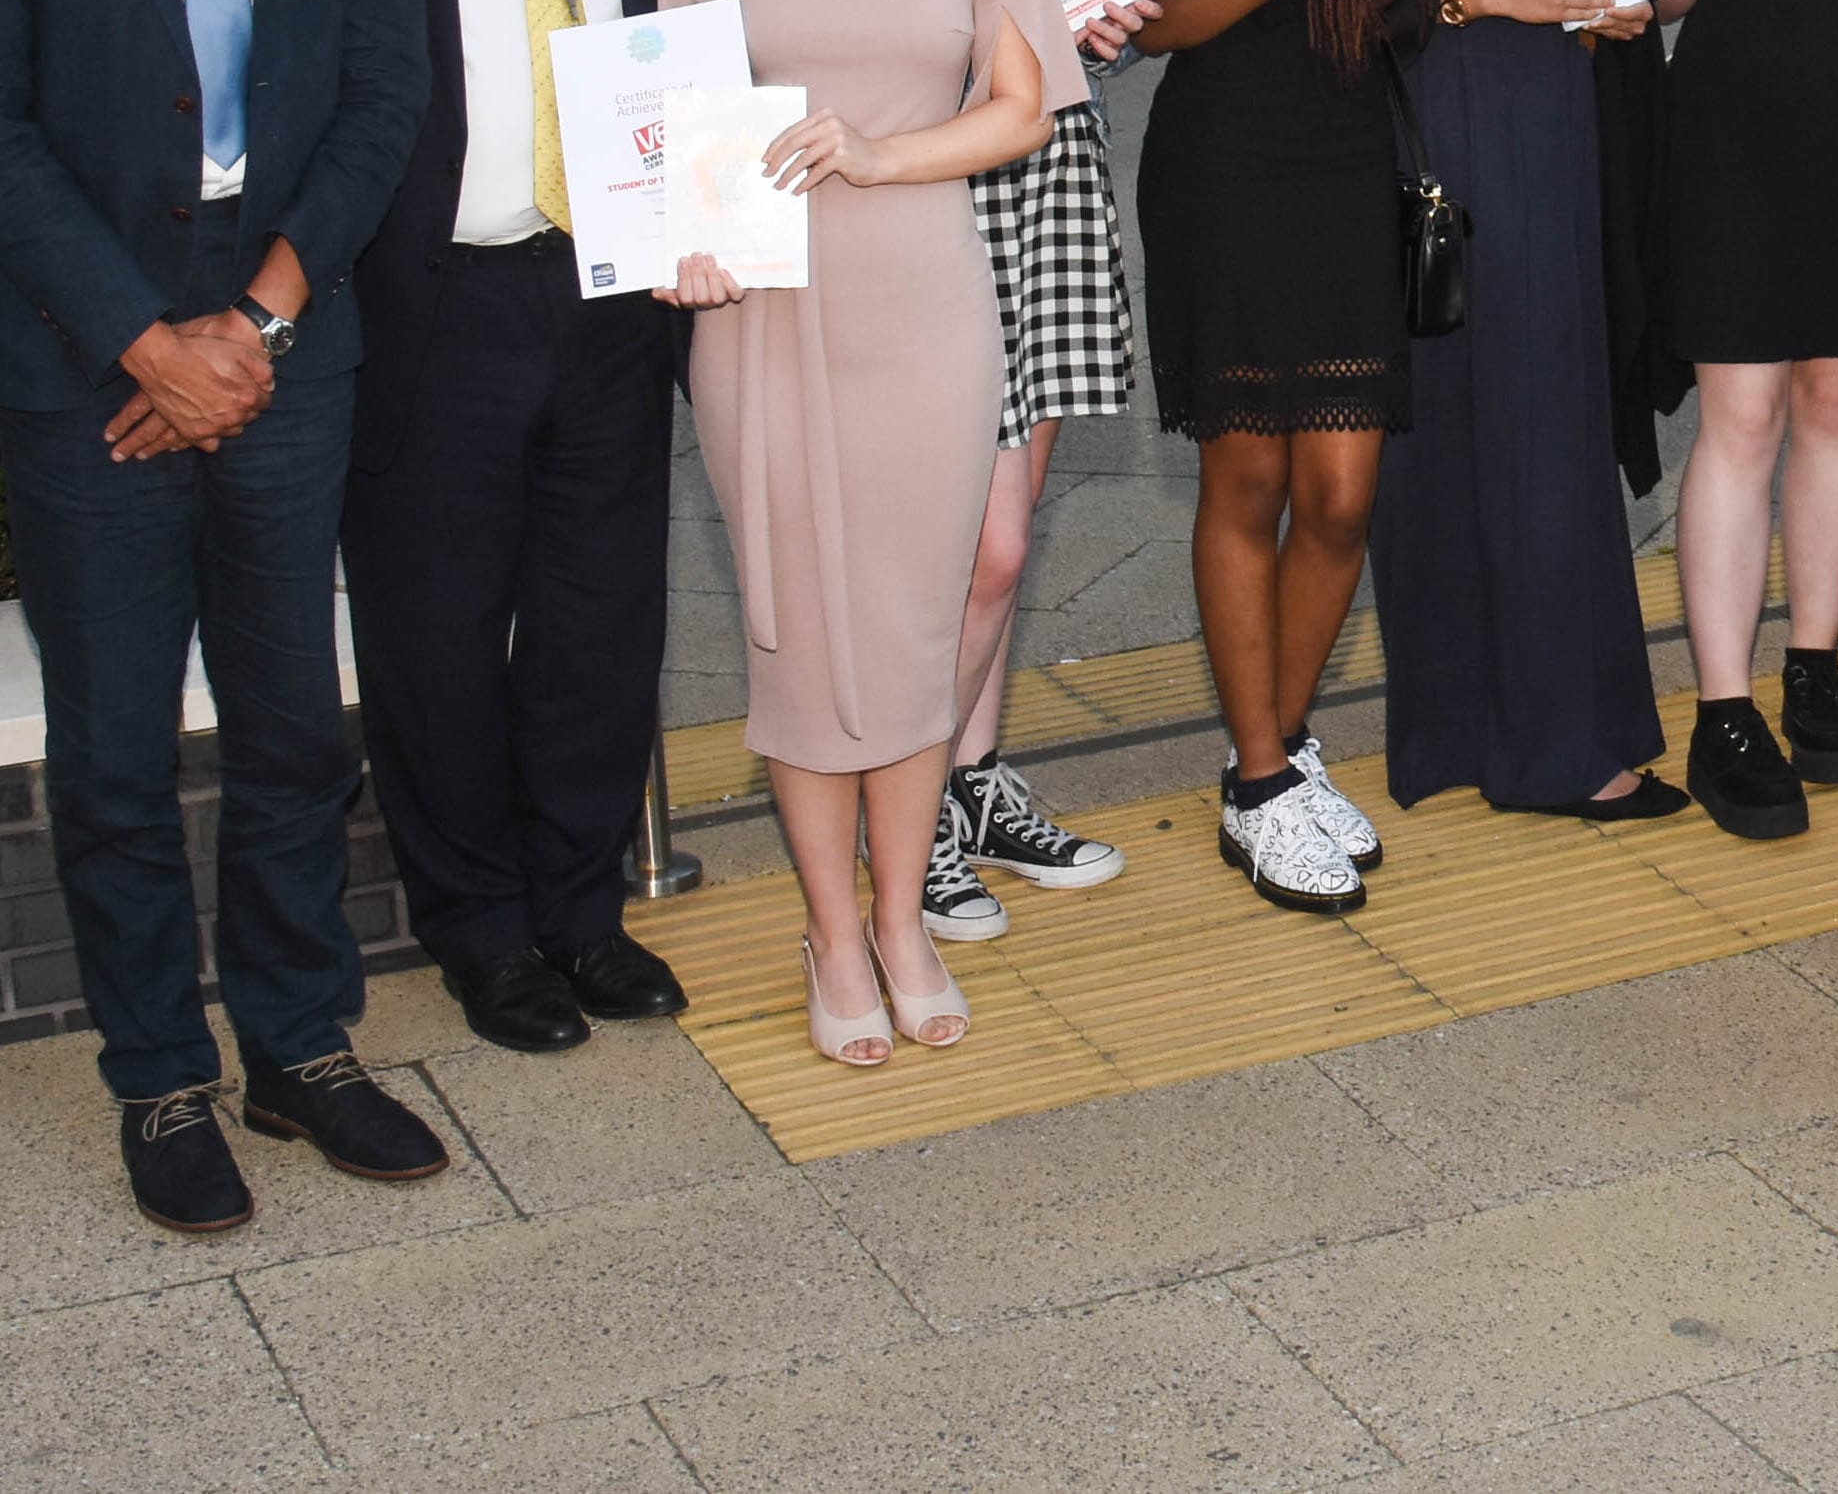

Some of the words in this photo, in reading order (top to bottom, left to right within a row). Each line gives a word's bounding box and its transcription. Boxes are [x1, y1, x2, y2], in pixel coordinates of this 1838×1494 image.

[617, 100, 664, 117] Achieve
[643, 151, 664, 165] AWA
[608, 178, 645, 193] STUDENT
[647, 177, 658, 186] OF
